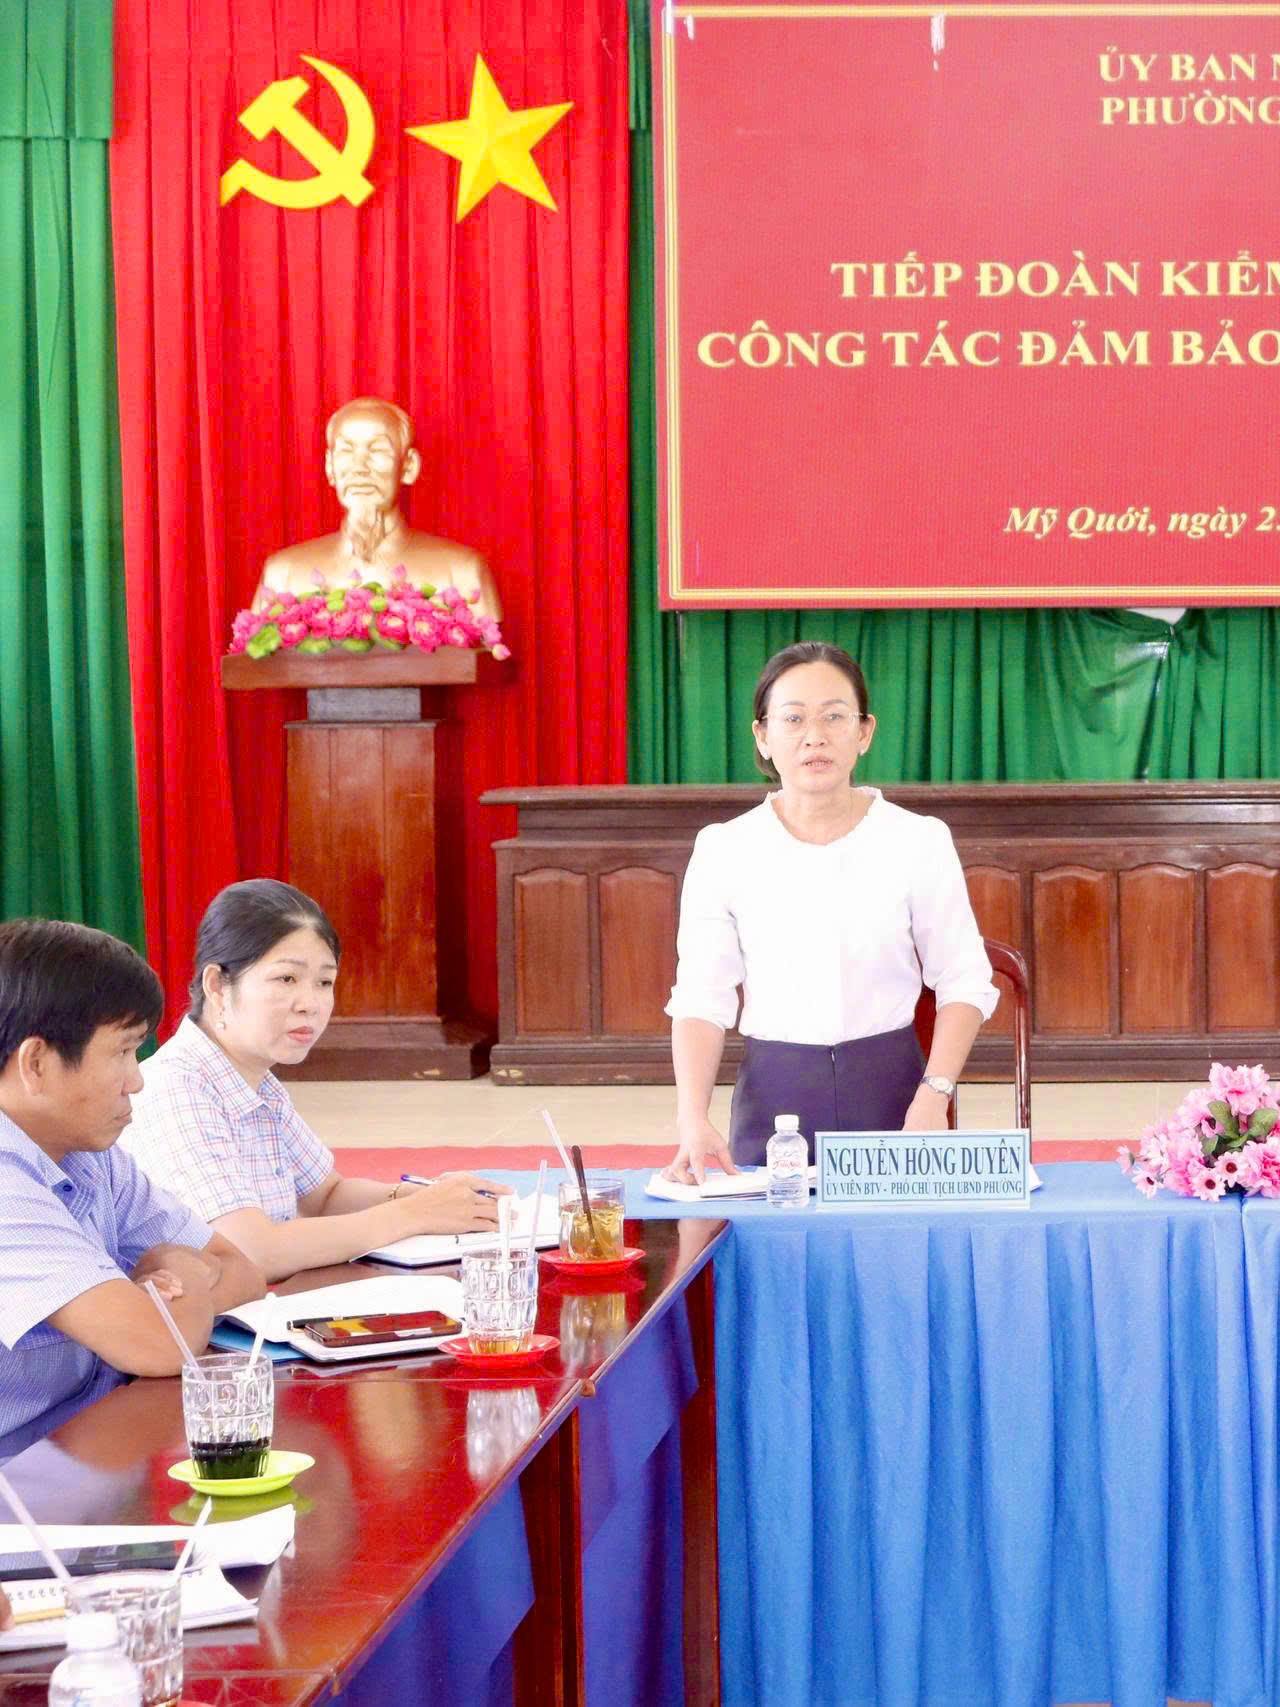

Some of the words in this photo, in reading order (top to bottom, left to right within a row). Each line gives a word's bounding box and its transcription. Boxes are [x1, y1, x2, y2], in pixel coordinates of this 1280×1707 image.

[1098, 45, 1158, 82] ỦY
[1169, 52, 1257, 82] BAN
[830, 251, 964, 298] TIẾP
[974, 250, 1141, 297] ĐOÀN
[697, 320, 867, 368] CÔNG
[881, 319, 1001, 367] TÁC
[1016, 319, 1152, 366] ĐẢM
[1003, 507, 1058, 539] Mỹ
[1067, 507, 1157, 539] Quới,
[1167, 506, 1248, 539] ngày
[826, 1139, 900, 1176] NGUYỄN
[960, 1137, 1021, 1175] DUYÊN
[840, 1178, 862, 1195] VIÊN
[864, 1182, 880, 1195] BTV
[932, 1181, 954, 1198] TỊCH
[957, 1181, 982, 1194] UBND
